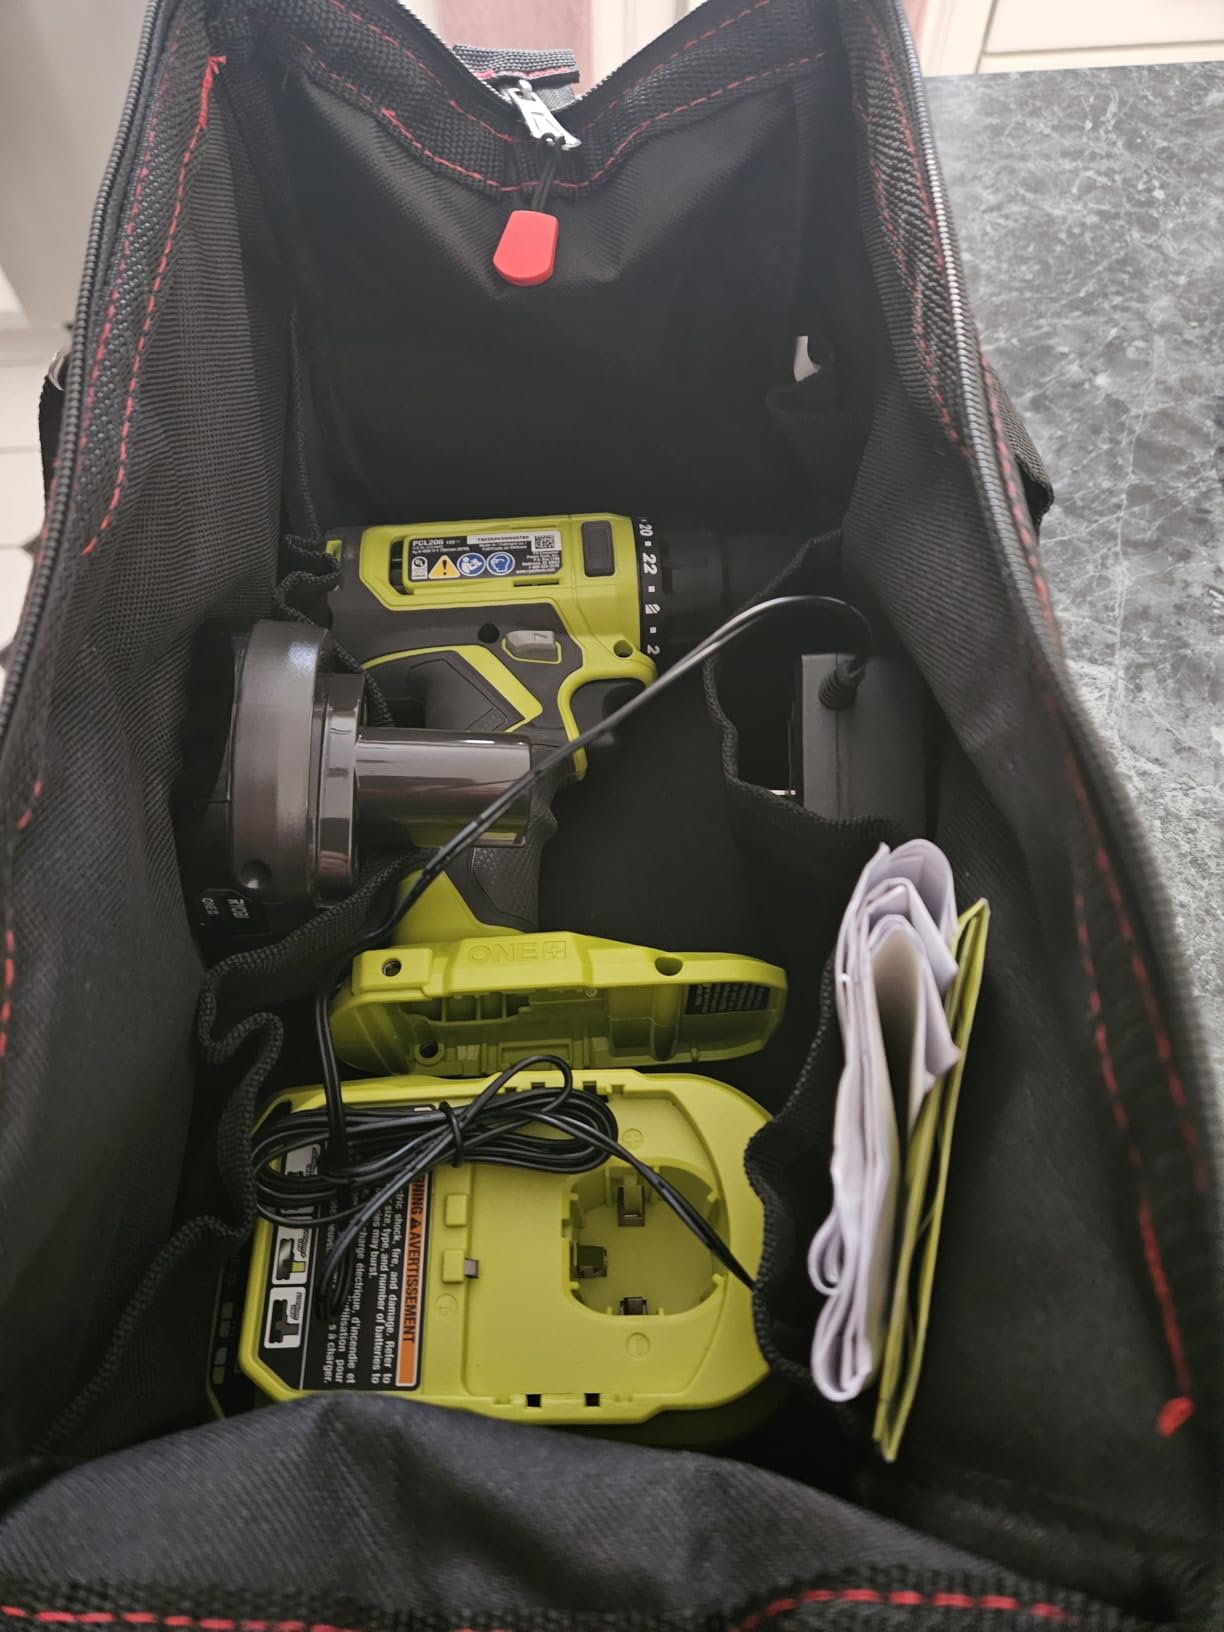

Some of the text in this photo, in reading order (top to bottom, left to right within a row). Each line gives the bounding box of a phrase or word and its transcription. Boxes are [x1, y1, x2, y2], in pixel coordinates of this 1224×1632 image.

[639, 524, 653, 537] 20
[642, 552, 658, 575] 22
[647, 644, 660, 655] 2
[369, 1229, 379, 1249] may
[392, 1213, 403, 1245] shock,
[369, 1251, 379, 1279] burst.
[390, 1248, 401, 1267] fire,
[389, 1271, 399, 1290] and
[403, 1231, 422, 1344] AVERTISSEMENT
[371, 1205, 393, 1384] size, type, and number of batteries to
[384, 1294, 398, 1337] damage.
[347, 1316, 361, 1369] d'incendie
[383, 1340, 395, 1368] Refer
[323, 1342, 336, 1384] charger.
[335, 1359, 345, 1383] pour
[345, 1373, 355, 1384] et
[382, 1373, 393, 1384] to
